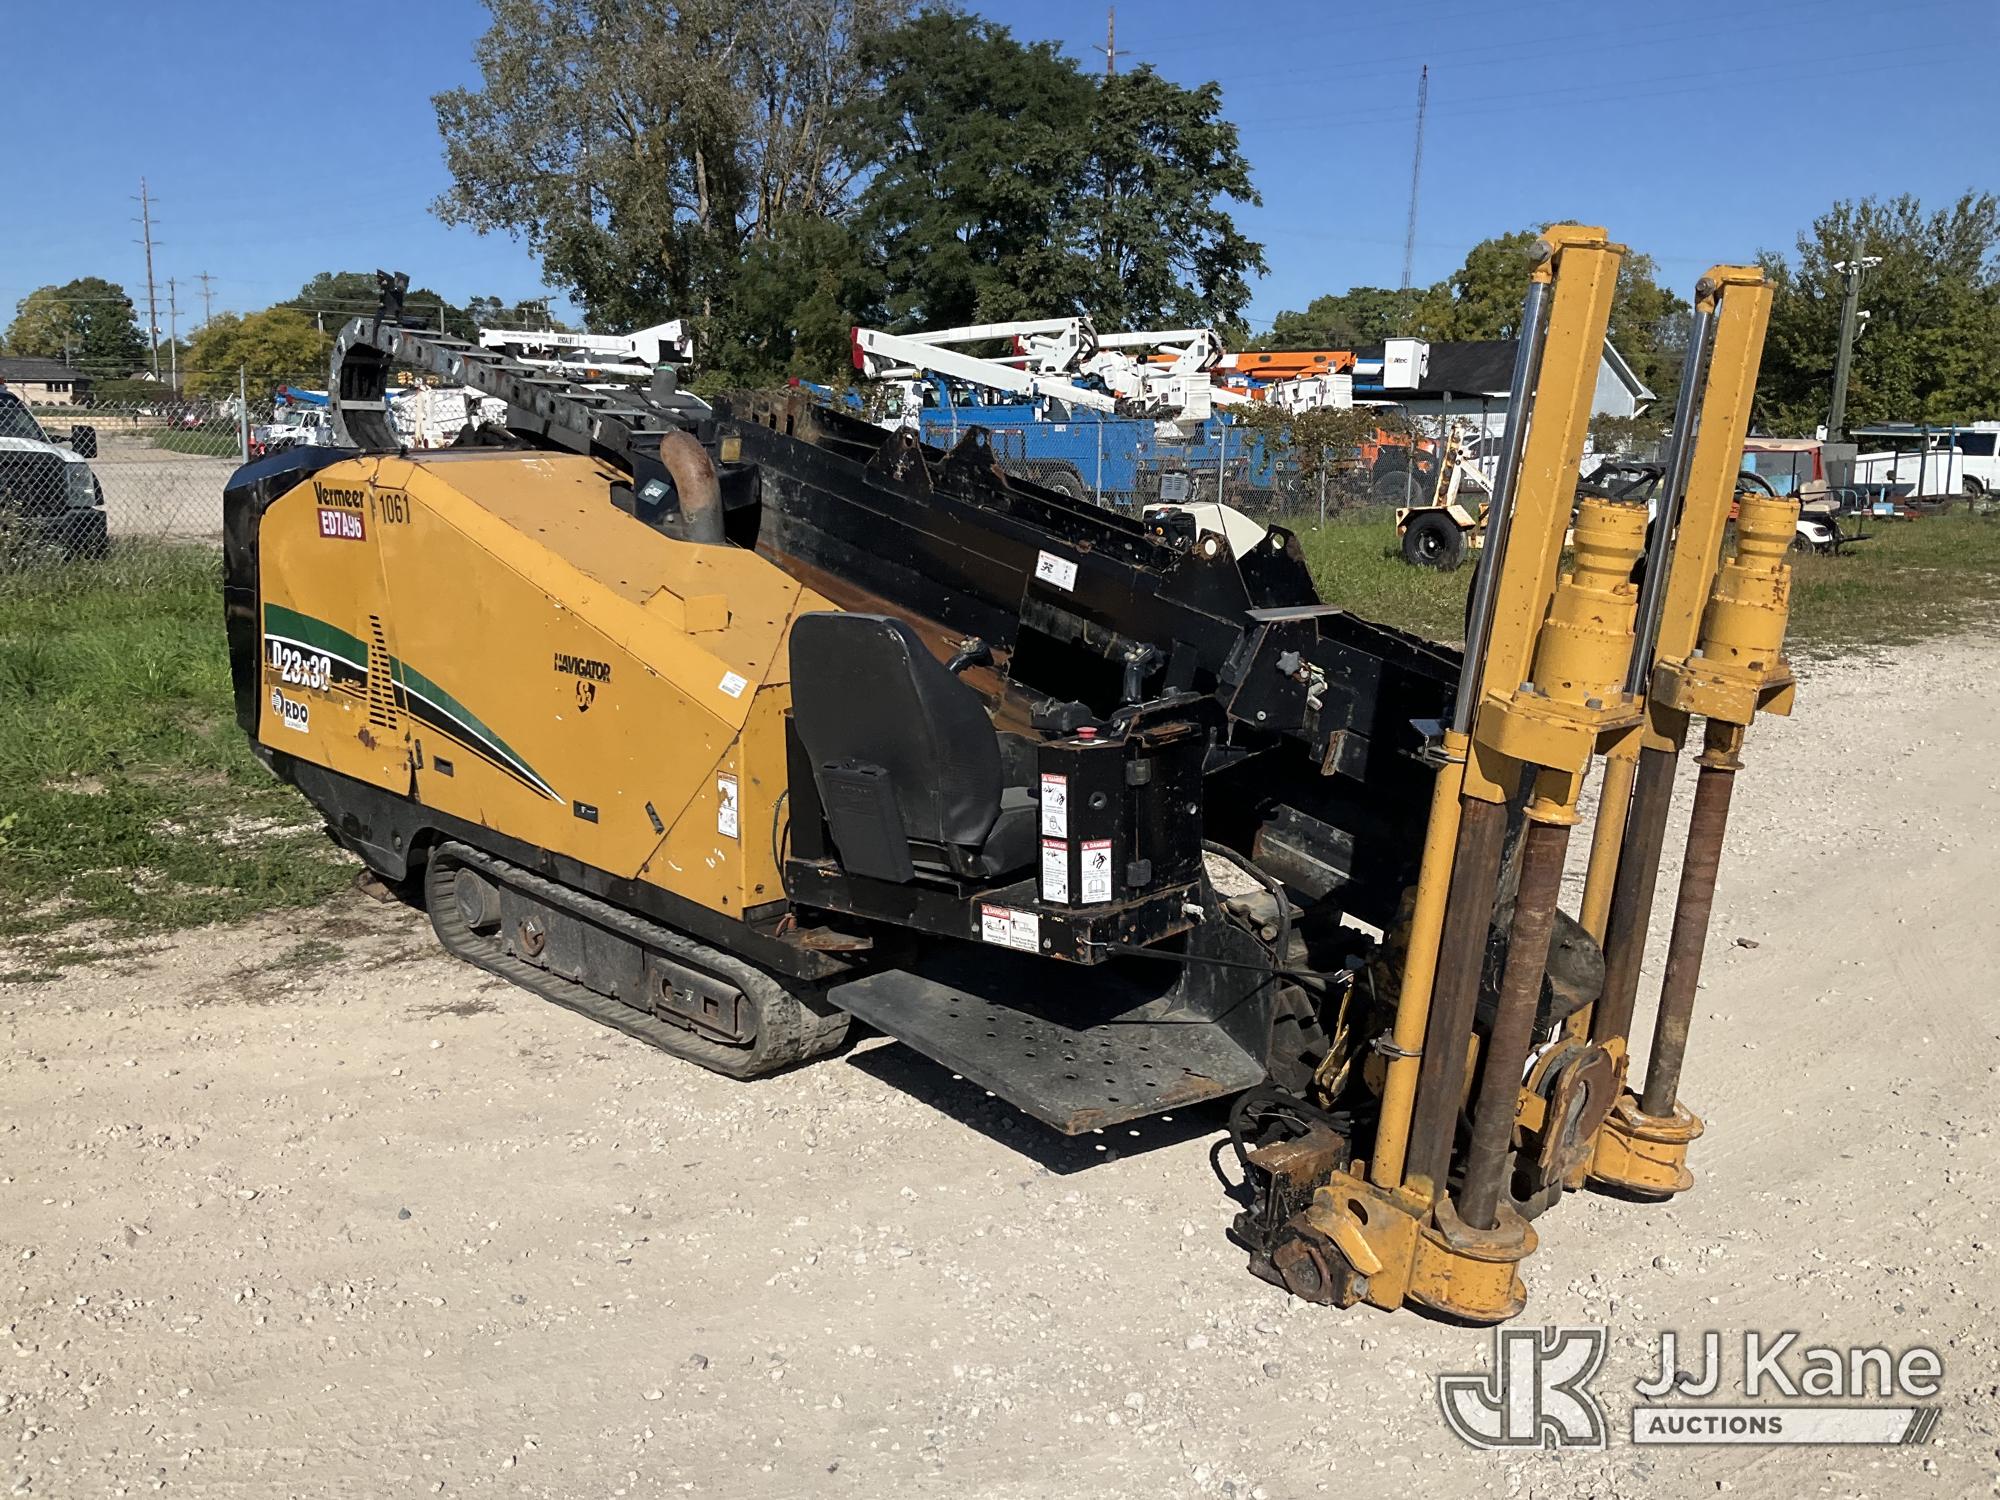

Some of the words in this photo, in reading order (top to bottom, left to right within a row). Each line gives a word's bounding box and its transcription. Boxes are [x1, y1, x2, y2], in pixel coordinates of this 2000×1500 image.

[313, 481, 364, 508] Vermeer
[379, 494, 410, 524] 1061
[321, 510, 362, 538] ED7A96
[554, 652, 610, 683] NAVIGATOR
[285, 699, 308, 723] RDO
